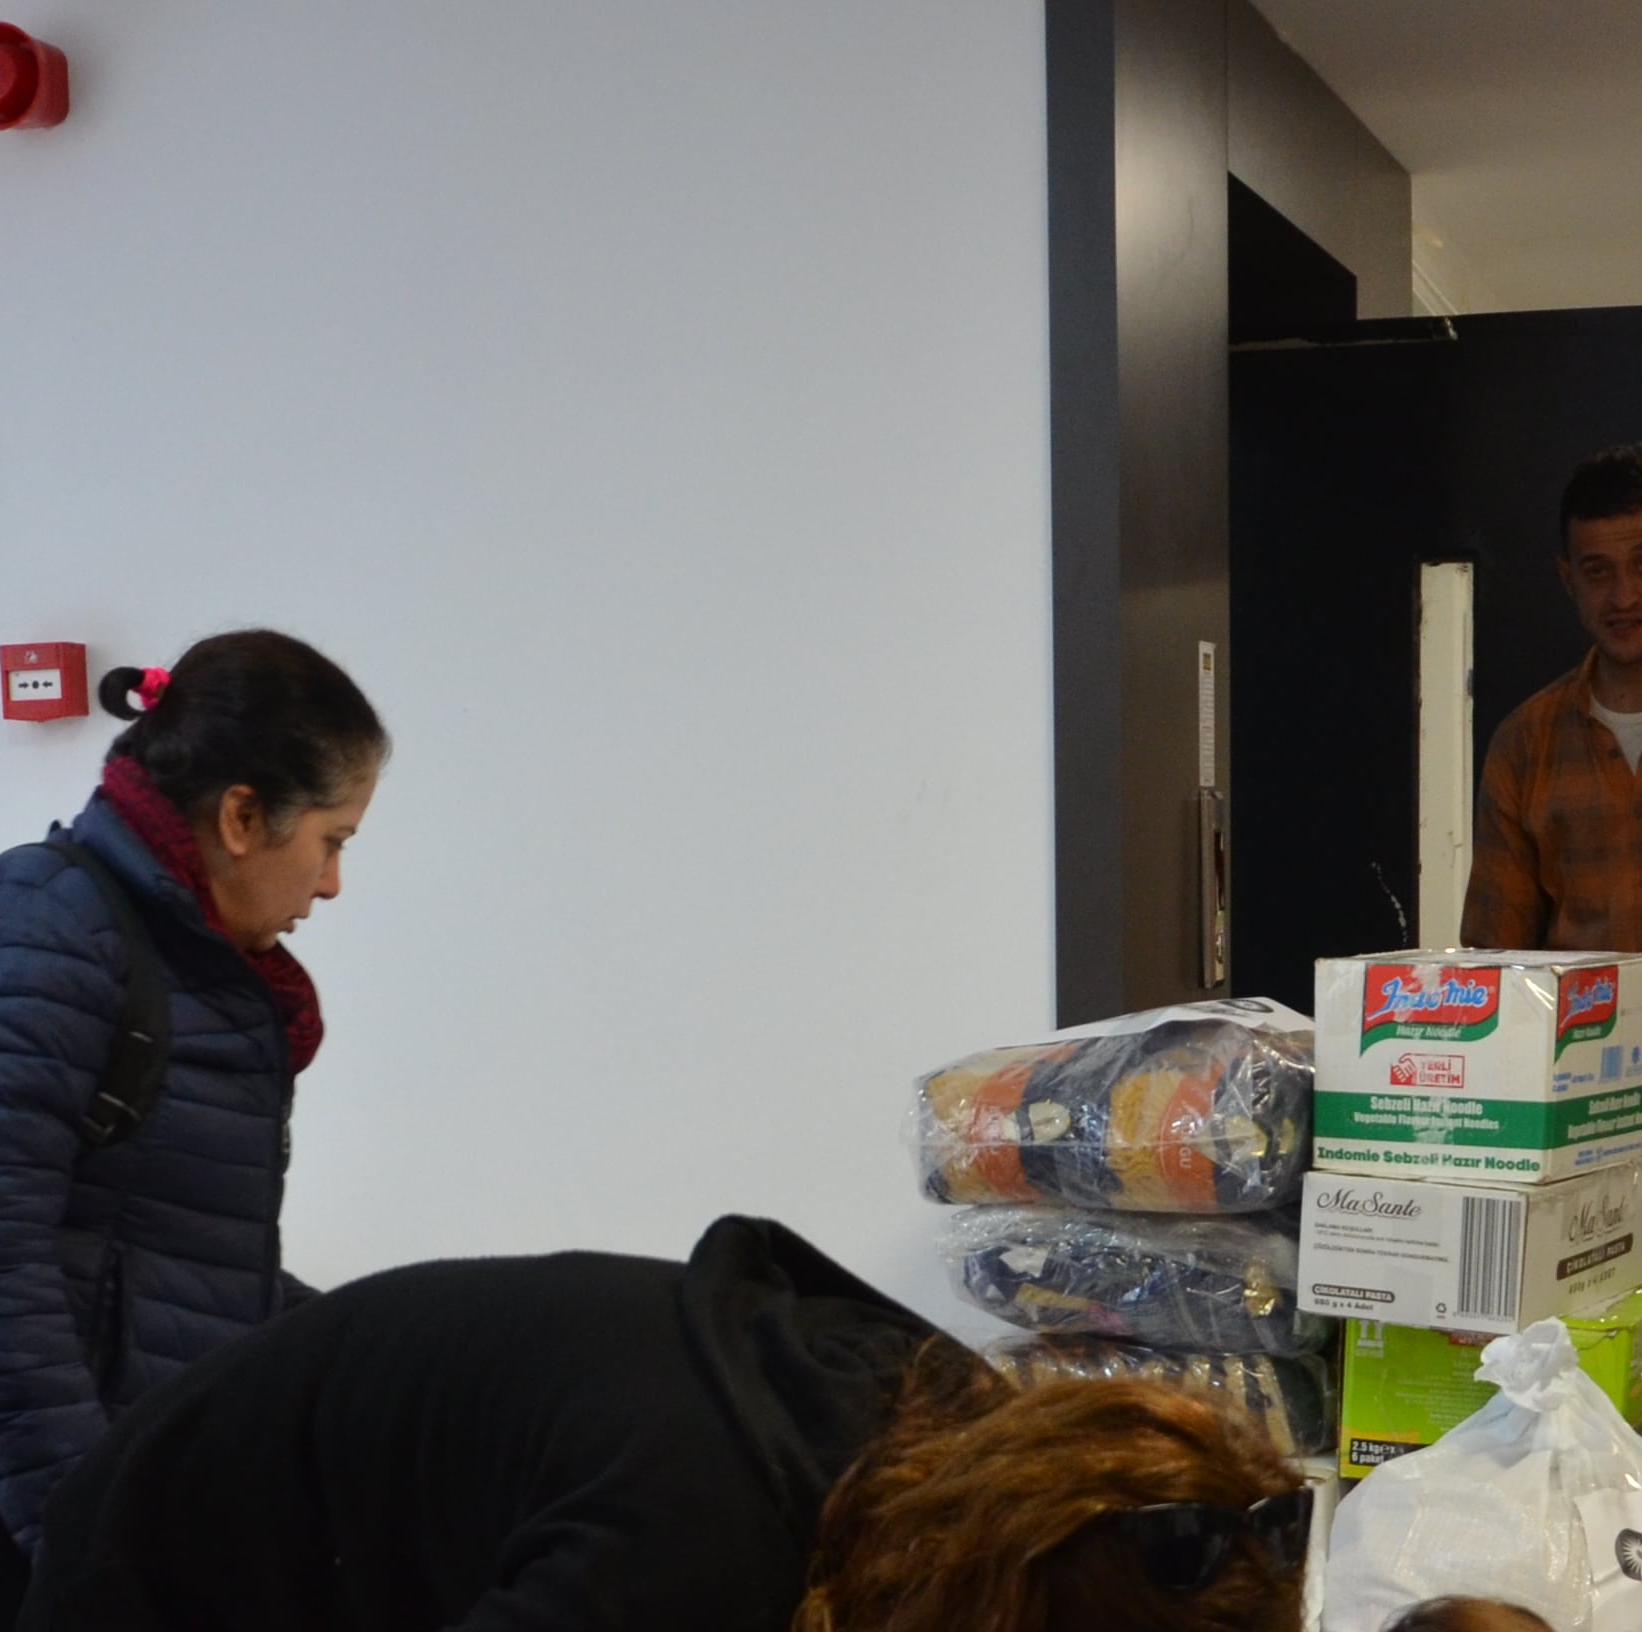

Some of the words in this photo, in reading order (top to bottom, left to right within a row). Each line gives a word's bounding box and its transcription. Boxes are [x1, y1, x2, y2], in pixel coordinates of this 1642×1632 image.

[1369, 1095, 1412, 1112] Sebzeli
[1317, 1146, 1380, 1163] Indomie
[1484, 1154, 1540, 1172] Noodle
[1364, 1288, 1393, 1302] PASTA
[1351, 1440, 1368, 1451] 2.5
[1351, 1452, 1358, 1463] 6
